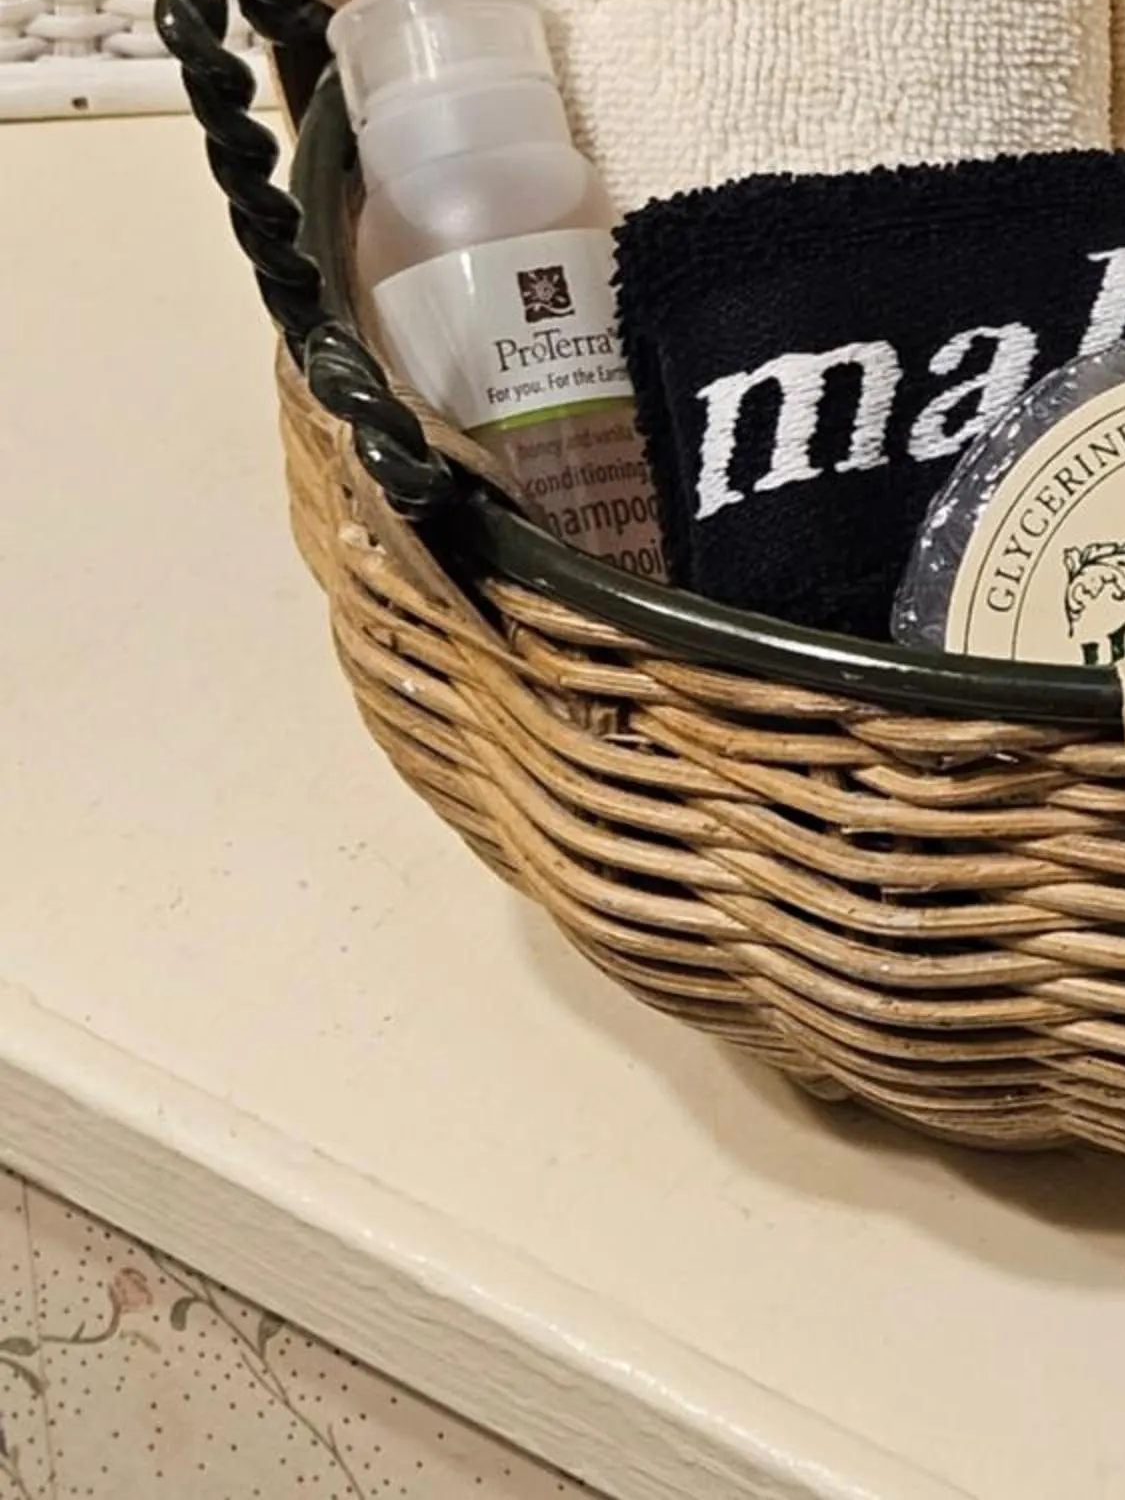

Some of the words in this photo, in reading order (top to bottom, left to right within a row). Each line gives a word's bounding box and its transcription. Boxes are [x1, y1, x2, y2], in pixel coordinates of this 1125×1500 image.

[484, 386, 510, 404] For
[548, 371, 570, 389] For
[573, 366, 596, 385] the
[548, 493, 661, 538] hampoo
